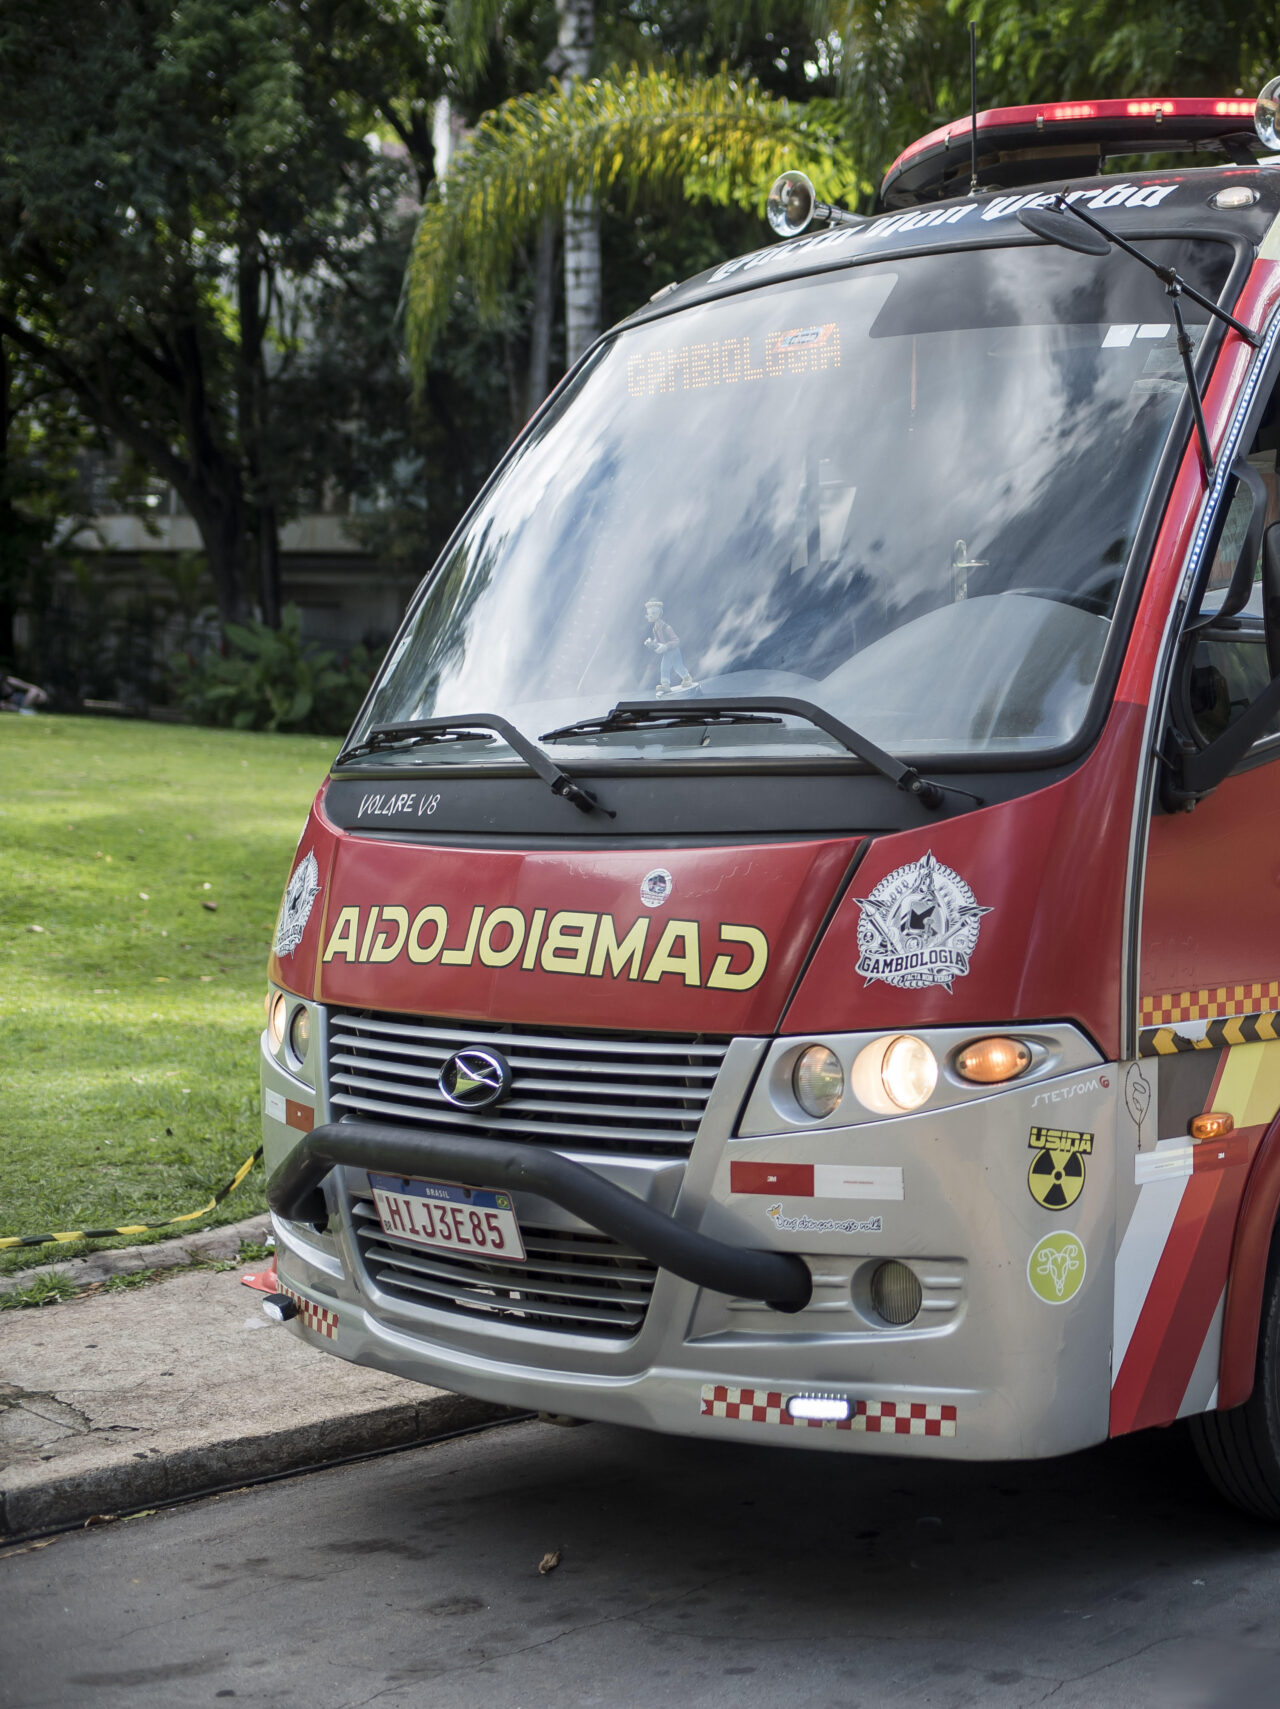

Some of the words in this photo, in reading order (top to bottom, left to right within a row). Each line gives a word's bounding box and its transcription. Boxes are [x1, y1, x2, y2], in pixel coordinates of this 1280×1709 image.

[357, 793, 417, 818] VOLARE
[417, 793, 441, 816] V8
[861, 949, 966, 974] GAMBIOLOGIA
[1031, 1079, 1099, 1108] STETSOM
[425, 1187, 450, 1199] BRASIL
[385, 1195, 505, 1250] HIJ3E85
